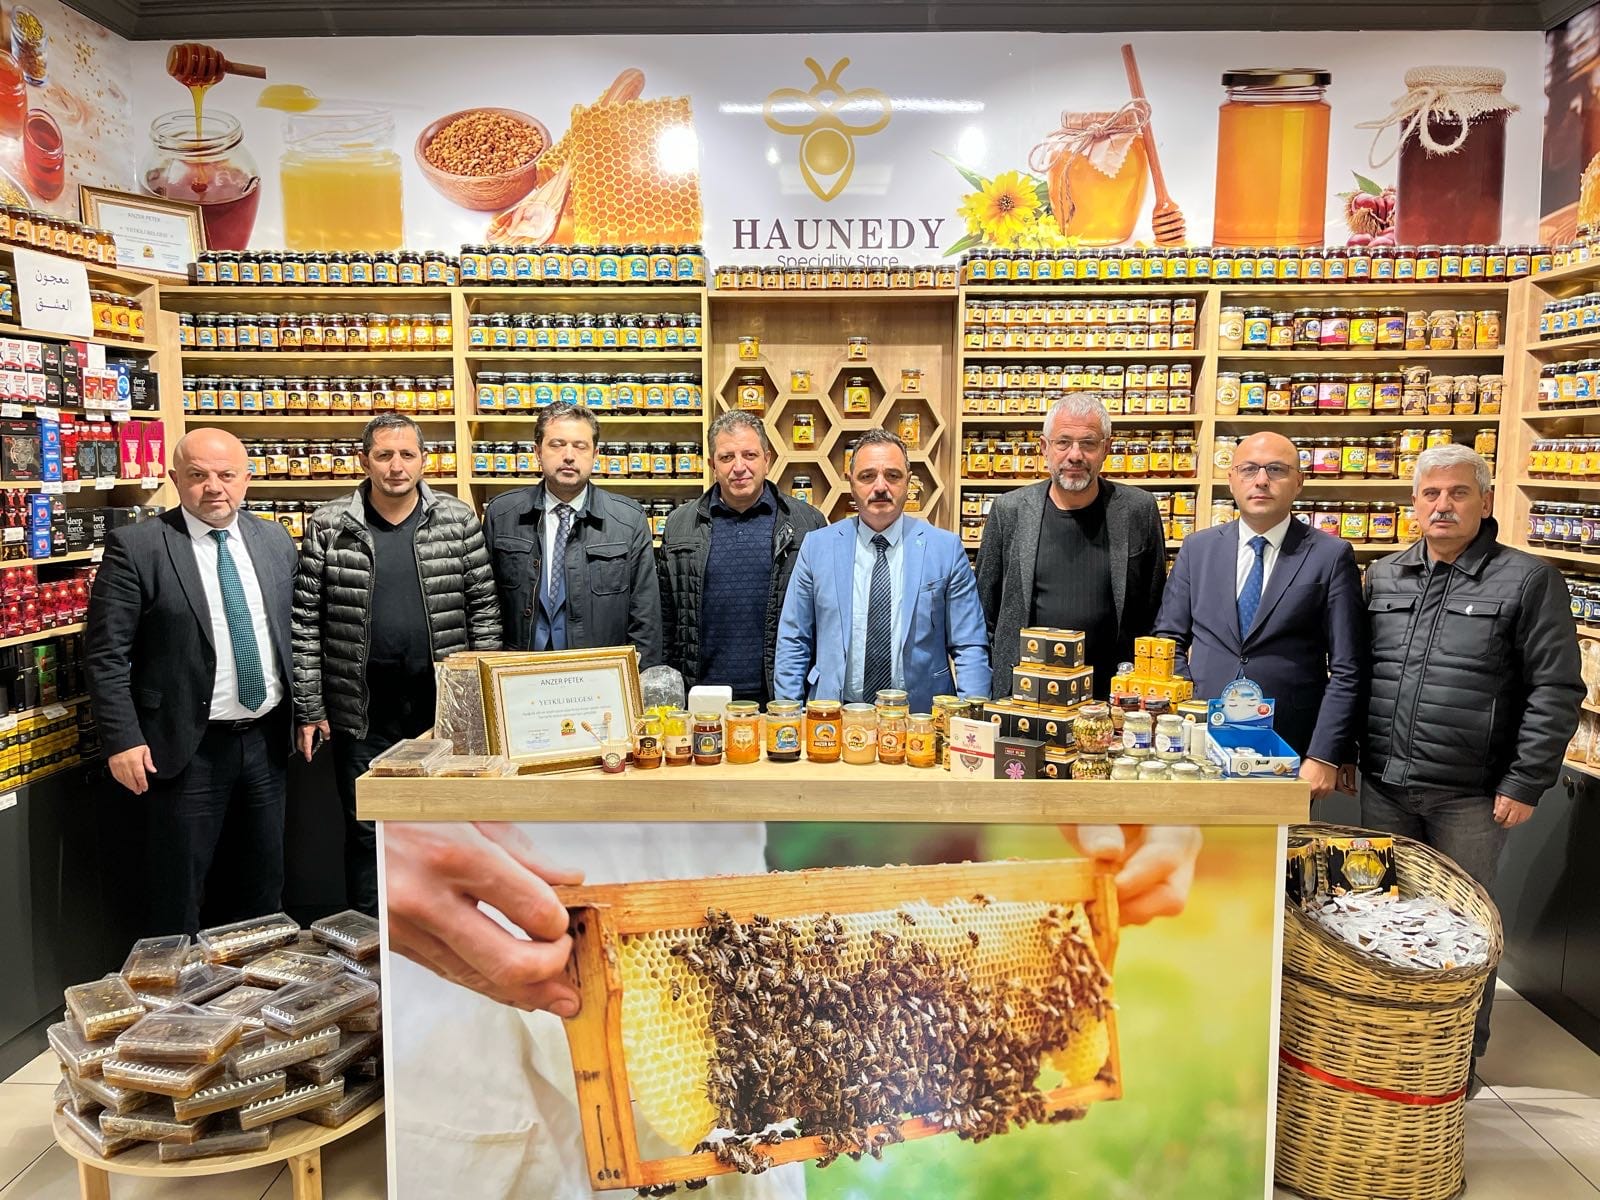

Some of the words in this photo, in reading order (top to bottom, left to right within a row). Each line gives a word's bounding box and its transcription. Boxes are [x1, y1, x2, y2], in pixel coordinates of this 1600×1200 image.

[732, 218, 945, 250] HAUNEDY
[777, 253, 852, 267] Speciality
[857, 253, 899, 267] Store
[35, 269, 70, 286] معجون
[66, 517, 83, 526] deep
[67, 525, 84, 533] force
[540, 677, 563, 686] ANZER
[564, 675, 584, 685] PETEK
